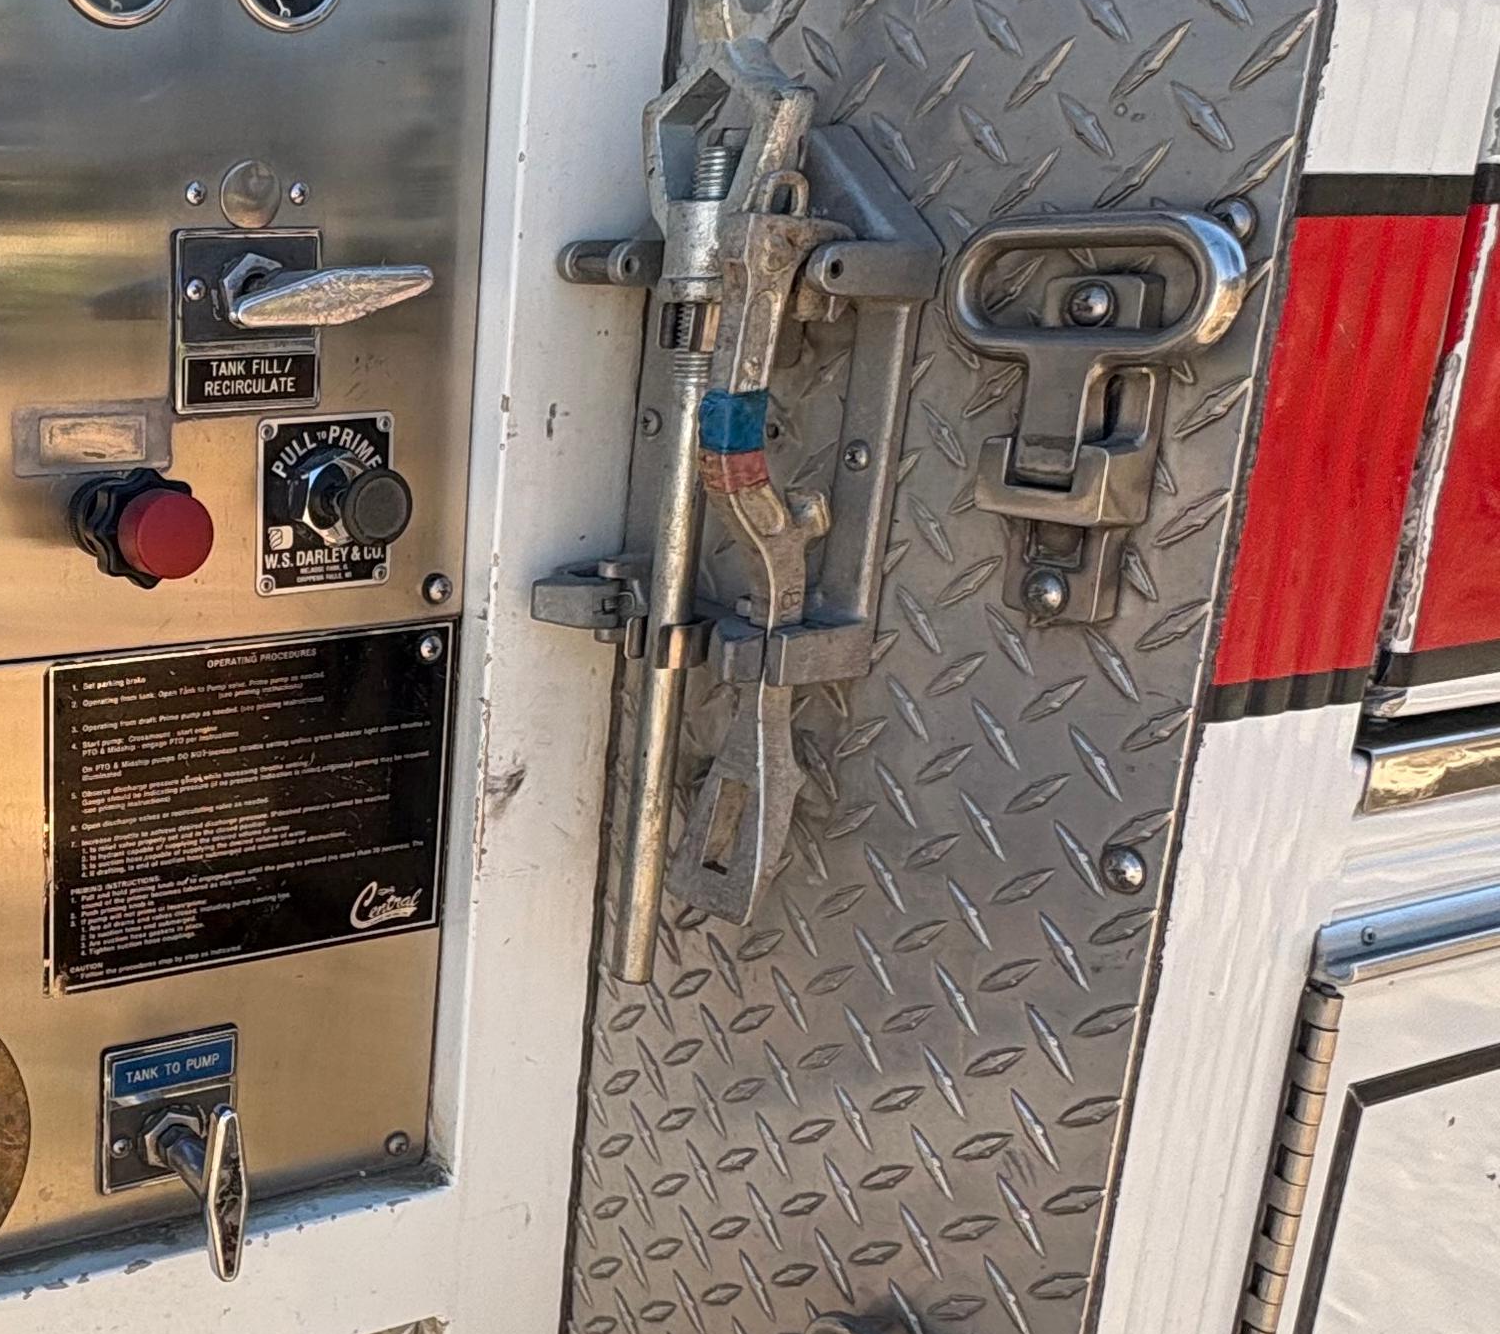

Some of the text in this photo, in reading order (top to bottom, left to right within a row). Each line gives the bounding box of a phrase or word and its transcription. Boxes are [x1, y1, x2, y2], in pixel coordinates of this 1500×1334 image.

[211, 361, 246, 376] TANK
[204, 377, 295, 396] RECIRCULATE
[271, 425, 382, 479] PULL PRIME
[265, 552, 293, 569] W.S.
[296, 547, 349, 566] DARLEY
[351, 546, 360, 561] &
[126, 1053, 220, 1083] TANK TO PUMP
